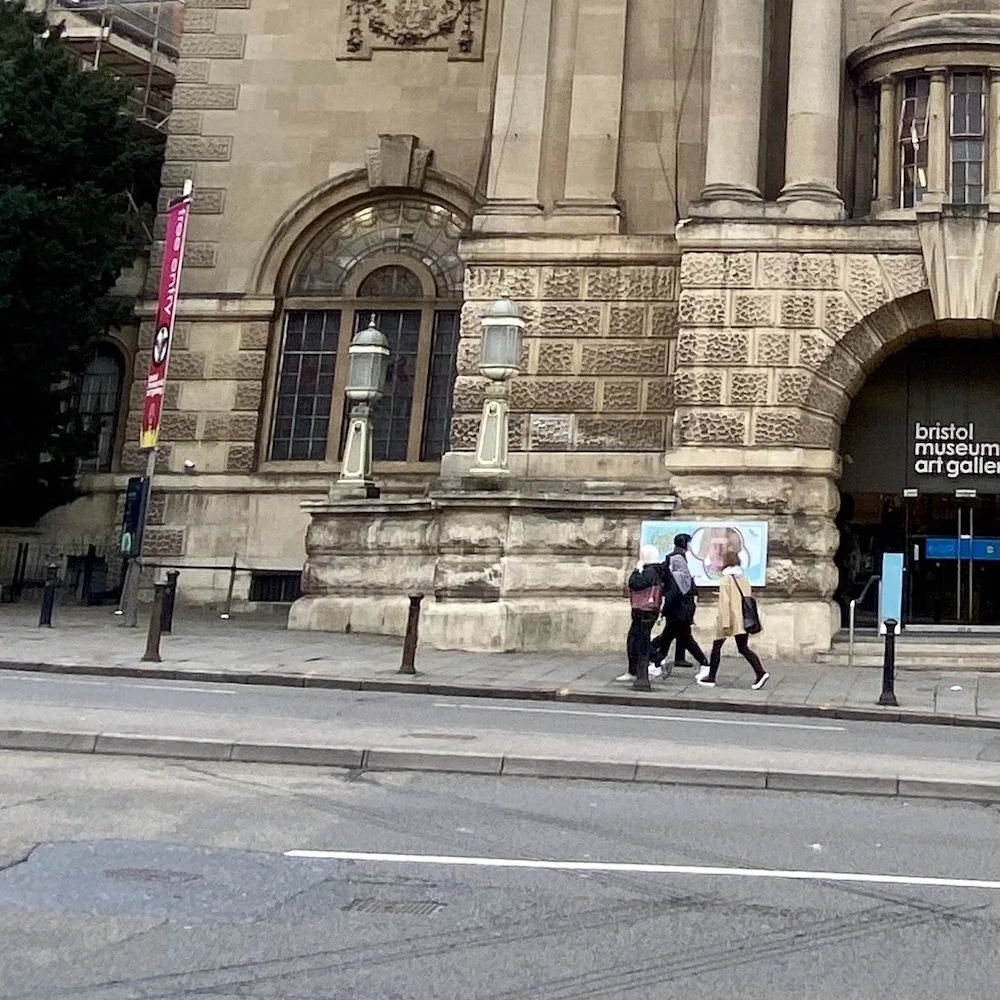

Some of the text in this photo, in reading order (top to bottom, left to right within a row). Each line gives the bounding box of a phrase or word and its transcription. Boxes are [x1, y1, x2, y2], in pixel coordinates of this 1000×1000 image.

[164, 208, 186, 315] free entry
[914, 422, 974, 440] bristol
[914, 442, 1000, 456] museum
[914, 456, 944, 473] art
